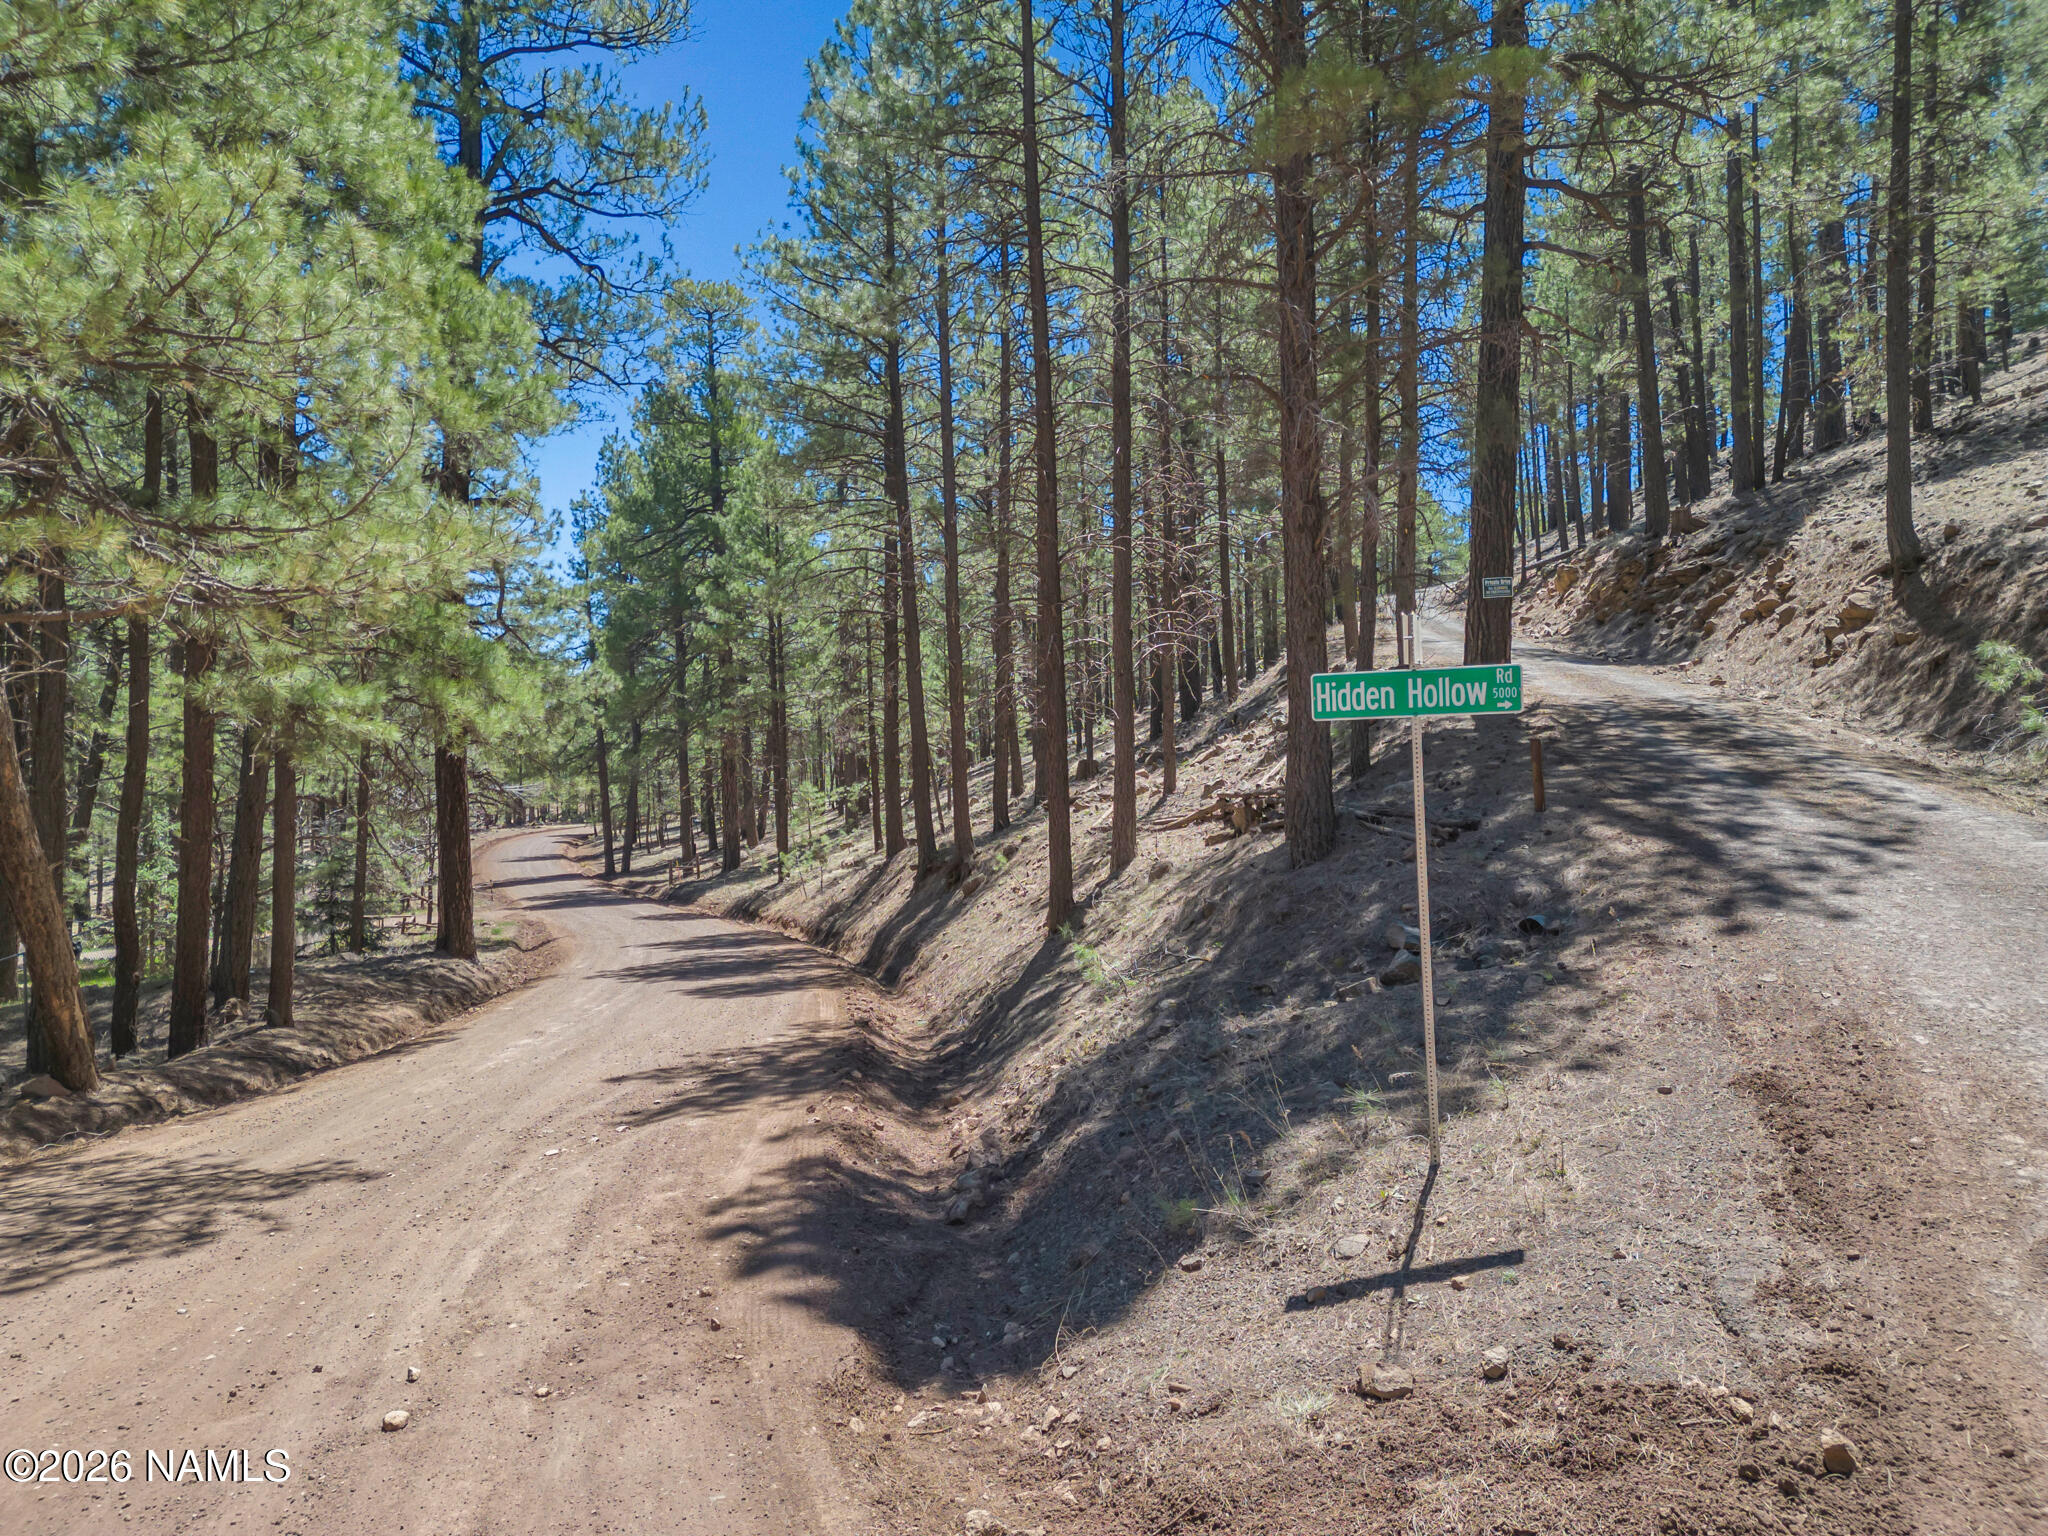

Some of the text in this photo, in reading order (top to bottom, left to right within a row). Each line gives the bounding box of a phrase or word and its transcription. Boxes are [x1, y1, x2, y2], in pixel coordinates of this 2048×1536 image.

[1496, 668, 1513, 684] Rd
[1316, 677, 1487, 712] Hidden Hollow
[1492, 687, 1518, 698] 5000
